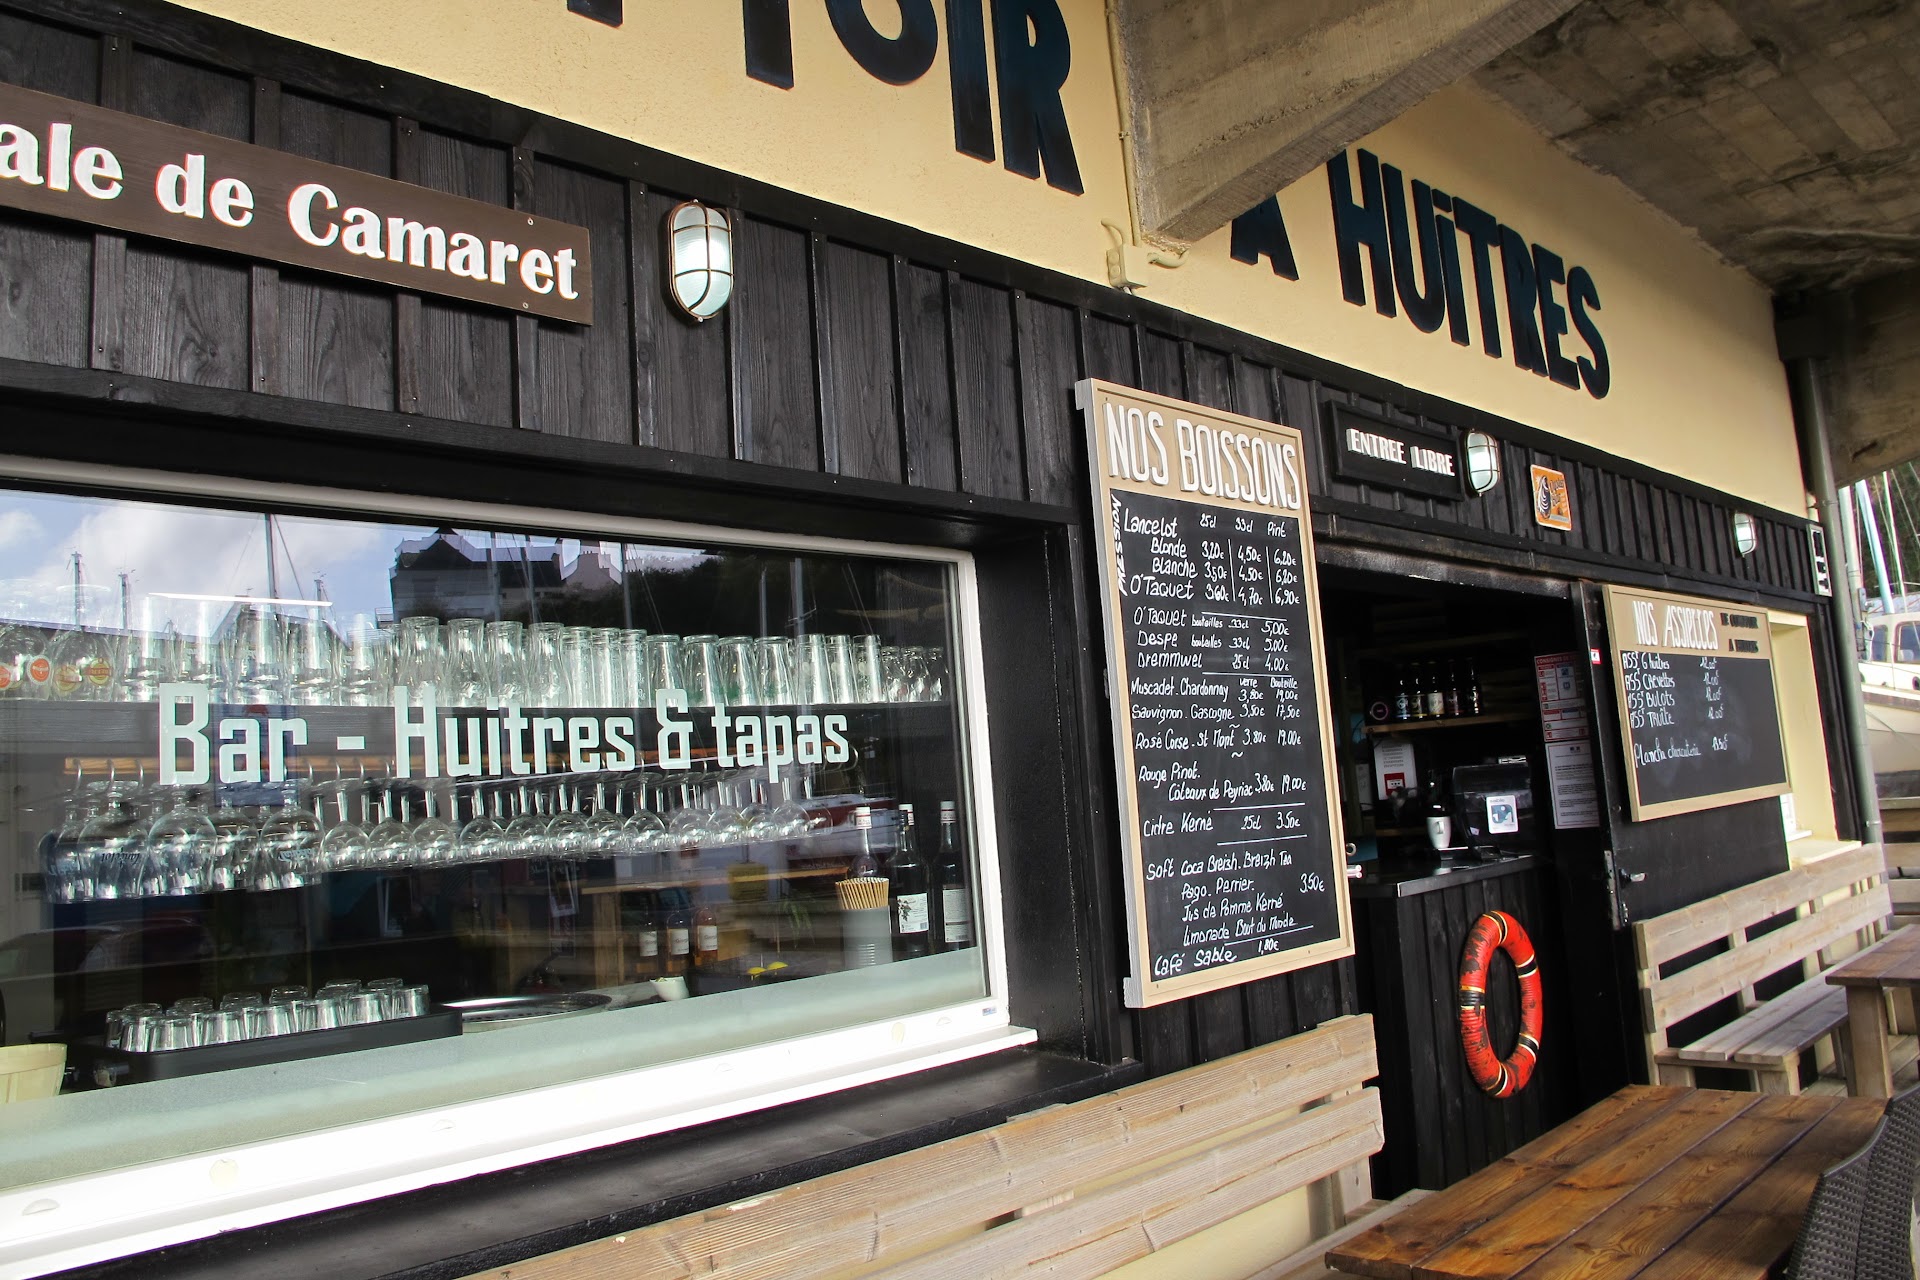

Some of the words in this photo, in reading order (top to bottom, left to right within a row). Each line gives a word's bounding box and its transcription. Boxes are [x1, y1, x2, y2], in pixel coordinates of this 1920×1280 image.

[156, 153, 254, 228] de
[287, 183, 579, 300] Camaret
[1103, 402, 1169, 486] NOS
[1174, 418, 1301, 510] BOISSONS
[1346, 428, 1407, 464] ENTREE
[1410, 446, 1456, 476] LIBRE
[1124, 508, 1178, 538] Lancelot
[1267, 522, 1287, 538] Pint
[1150, 537, 1188, 559] Blonde
[1238, 545, 1262, 564] 4,50€
[1152, 557, 1198, 579] Blanche
[1238, 586, 1264, 606] 4,70€
[1274, 588, 1300, 606] 6,90€
[1261, 621, 1290, 637] 5,00€
[1633, 601, 1659, 646] NOS
[1138, 630, 1178, 651] Despe
[1138, 652, 1203, 668] Dremmwel
[1180, 677, 1229, 702] Chardonnay
[159, 682, 308, 786] Bar
[393, 685, 637, 780] Huitres
[656, 688, 694, 771] &
[711, 703, 851, 784] tapas
[1136, 732, 1162, 750] Rosé
[1196, 730, 1208, 748] St
[1138, 766, 1167, 789] Rouge
[1208, 780, 1220, 800] de
[1223, 780, 1254, 804] Peyriac
[1144, 814, 1175, 837] Cidre
[1180, 860, 1204, 876] Coca
[1243, 848, 1276, 870] Breizh
[1182, 904, 1200, 922] Jus
[1202, 902, 1216, 919] de
[1220, 898, 1253, 917] Pomme
[1183, 922, 1230, 947] Limonade
[1256, 916, 1266, 933] du
[1154, 952, 1186, 976] Café
